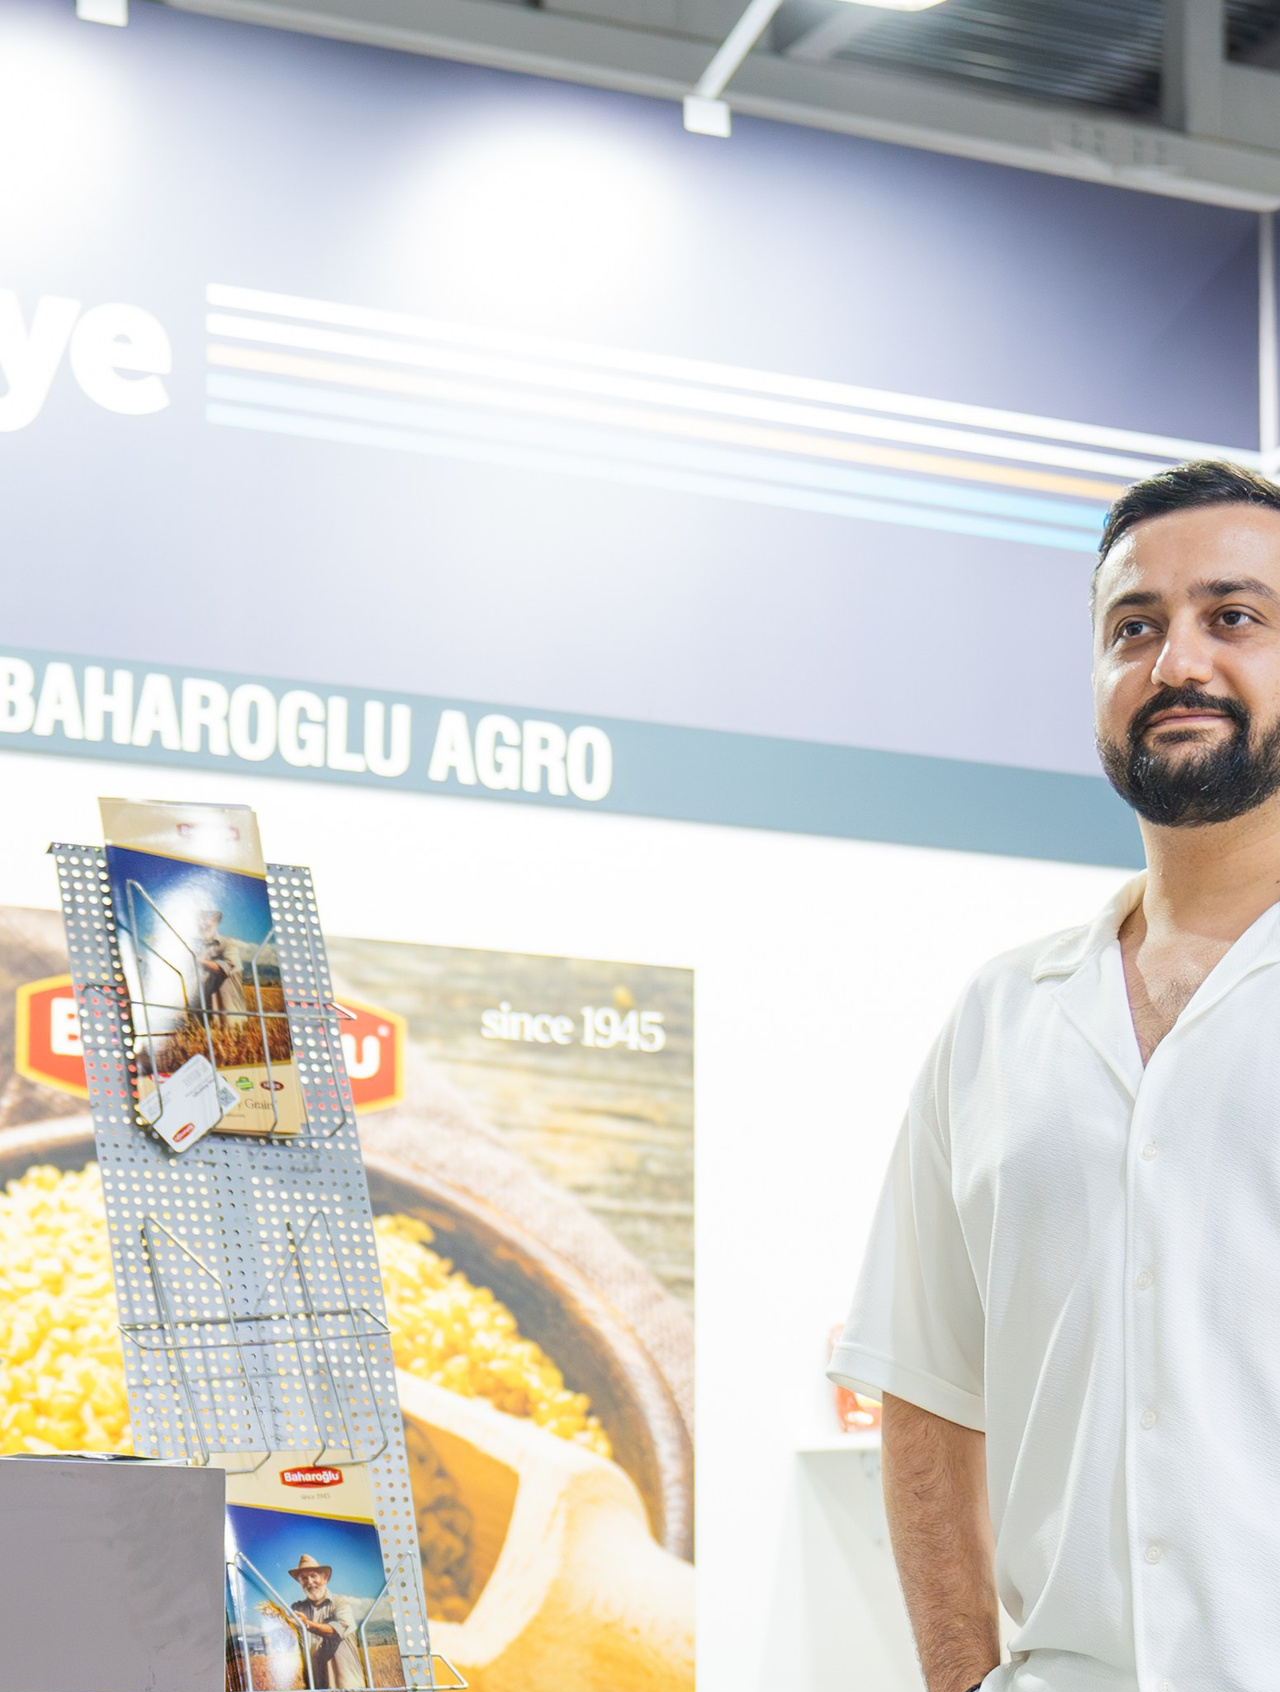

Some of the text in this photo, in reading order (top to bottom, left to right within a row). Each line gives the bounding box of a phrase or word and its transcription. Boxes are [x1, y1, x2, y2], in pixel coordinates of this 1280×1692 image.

[0, 657, 612, 801] BAHAROGLU AGRO
[481, 1002, 666, 1052] since 1945
